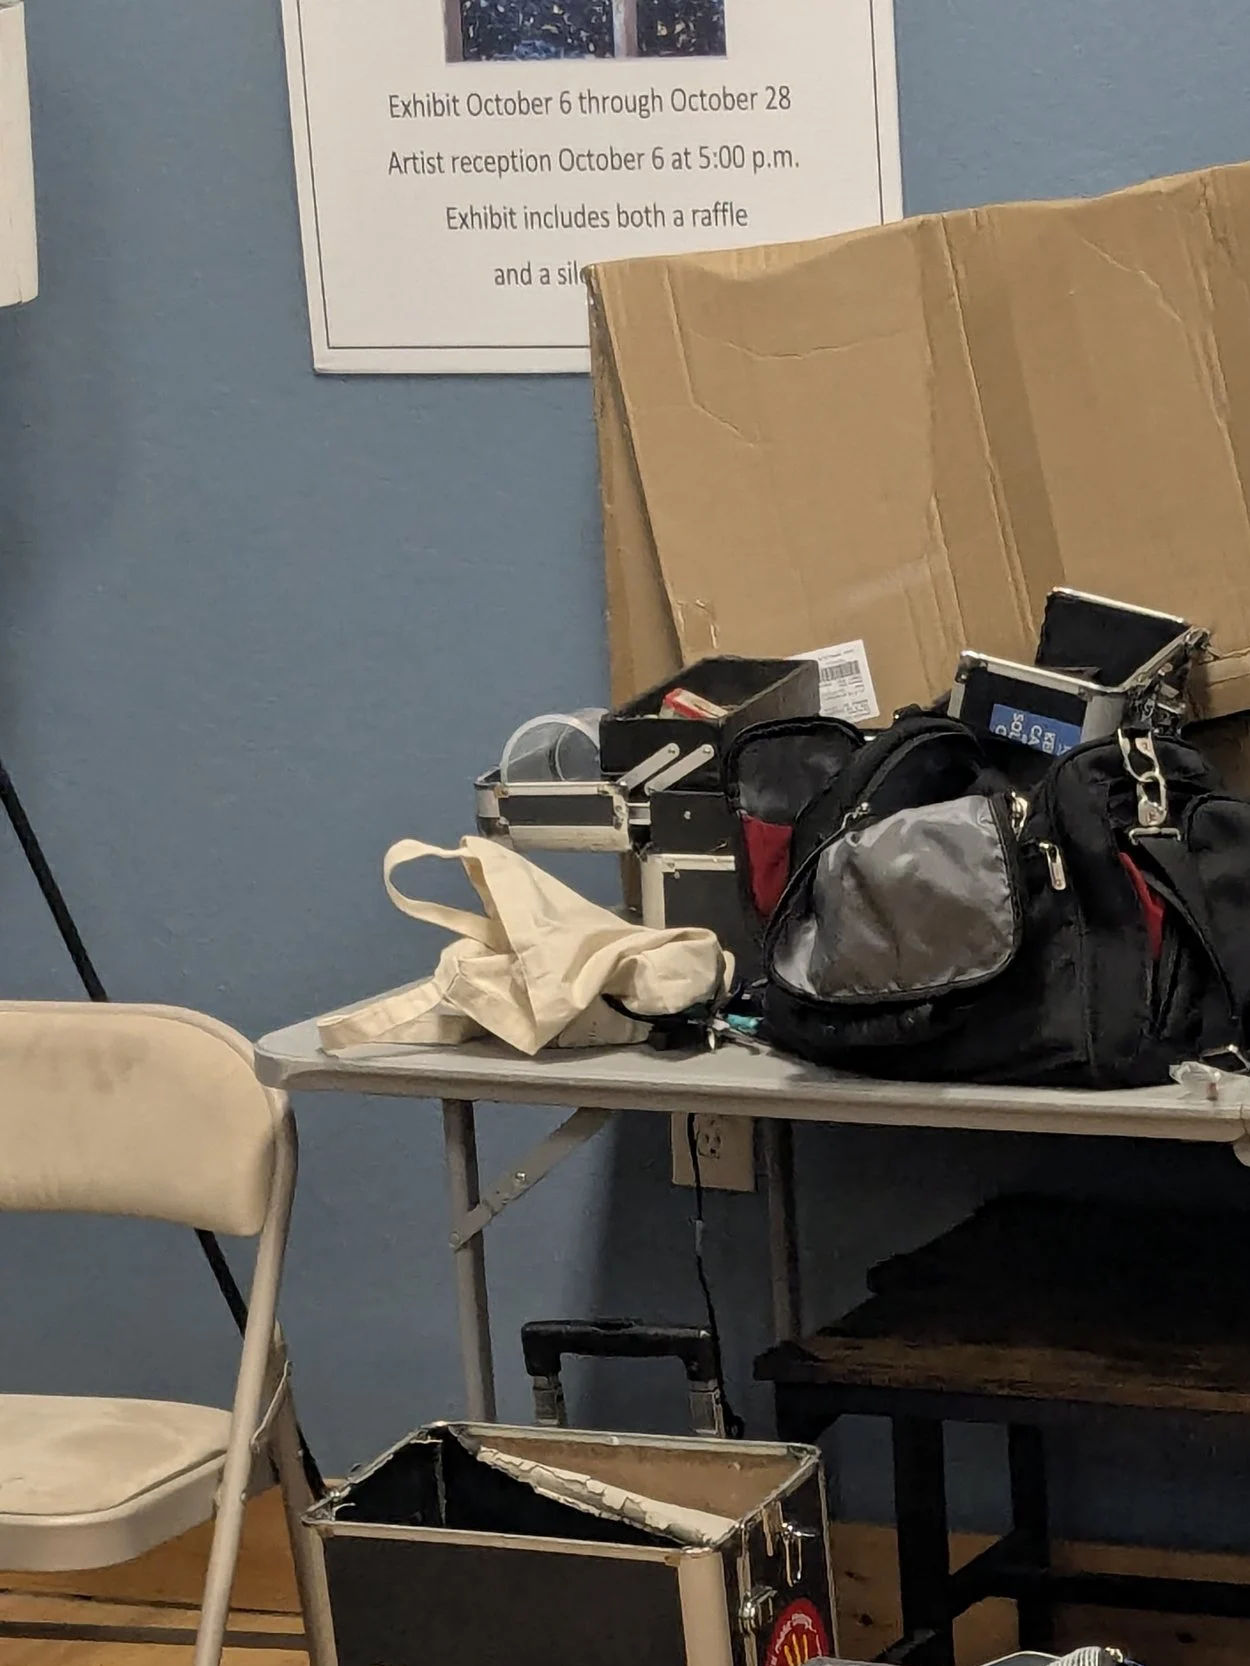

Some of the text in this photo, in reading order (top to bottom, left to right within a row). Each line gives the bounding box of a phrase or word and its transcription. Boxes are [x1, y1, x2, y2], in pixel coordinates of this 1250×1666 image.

[389, 85, 791, 119] Exhibit October 6 through October 28
[388, 145, 800, 178] Artist reception October 6 at 5:00 p.m.
[447, 201, 748, 230] Exhibit includes both a raffle
[495, 262, 532, 285] and
[540, 268, 550, 285] a
